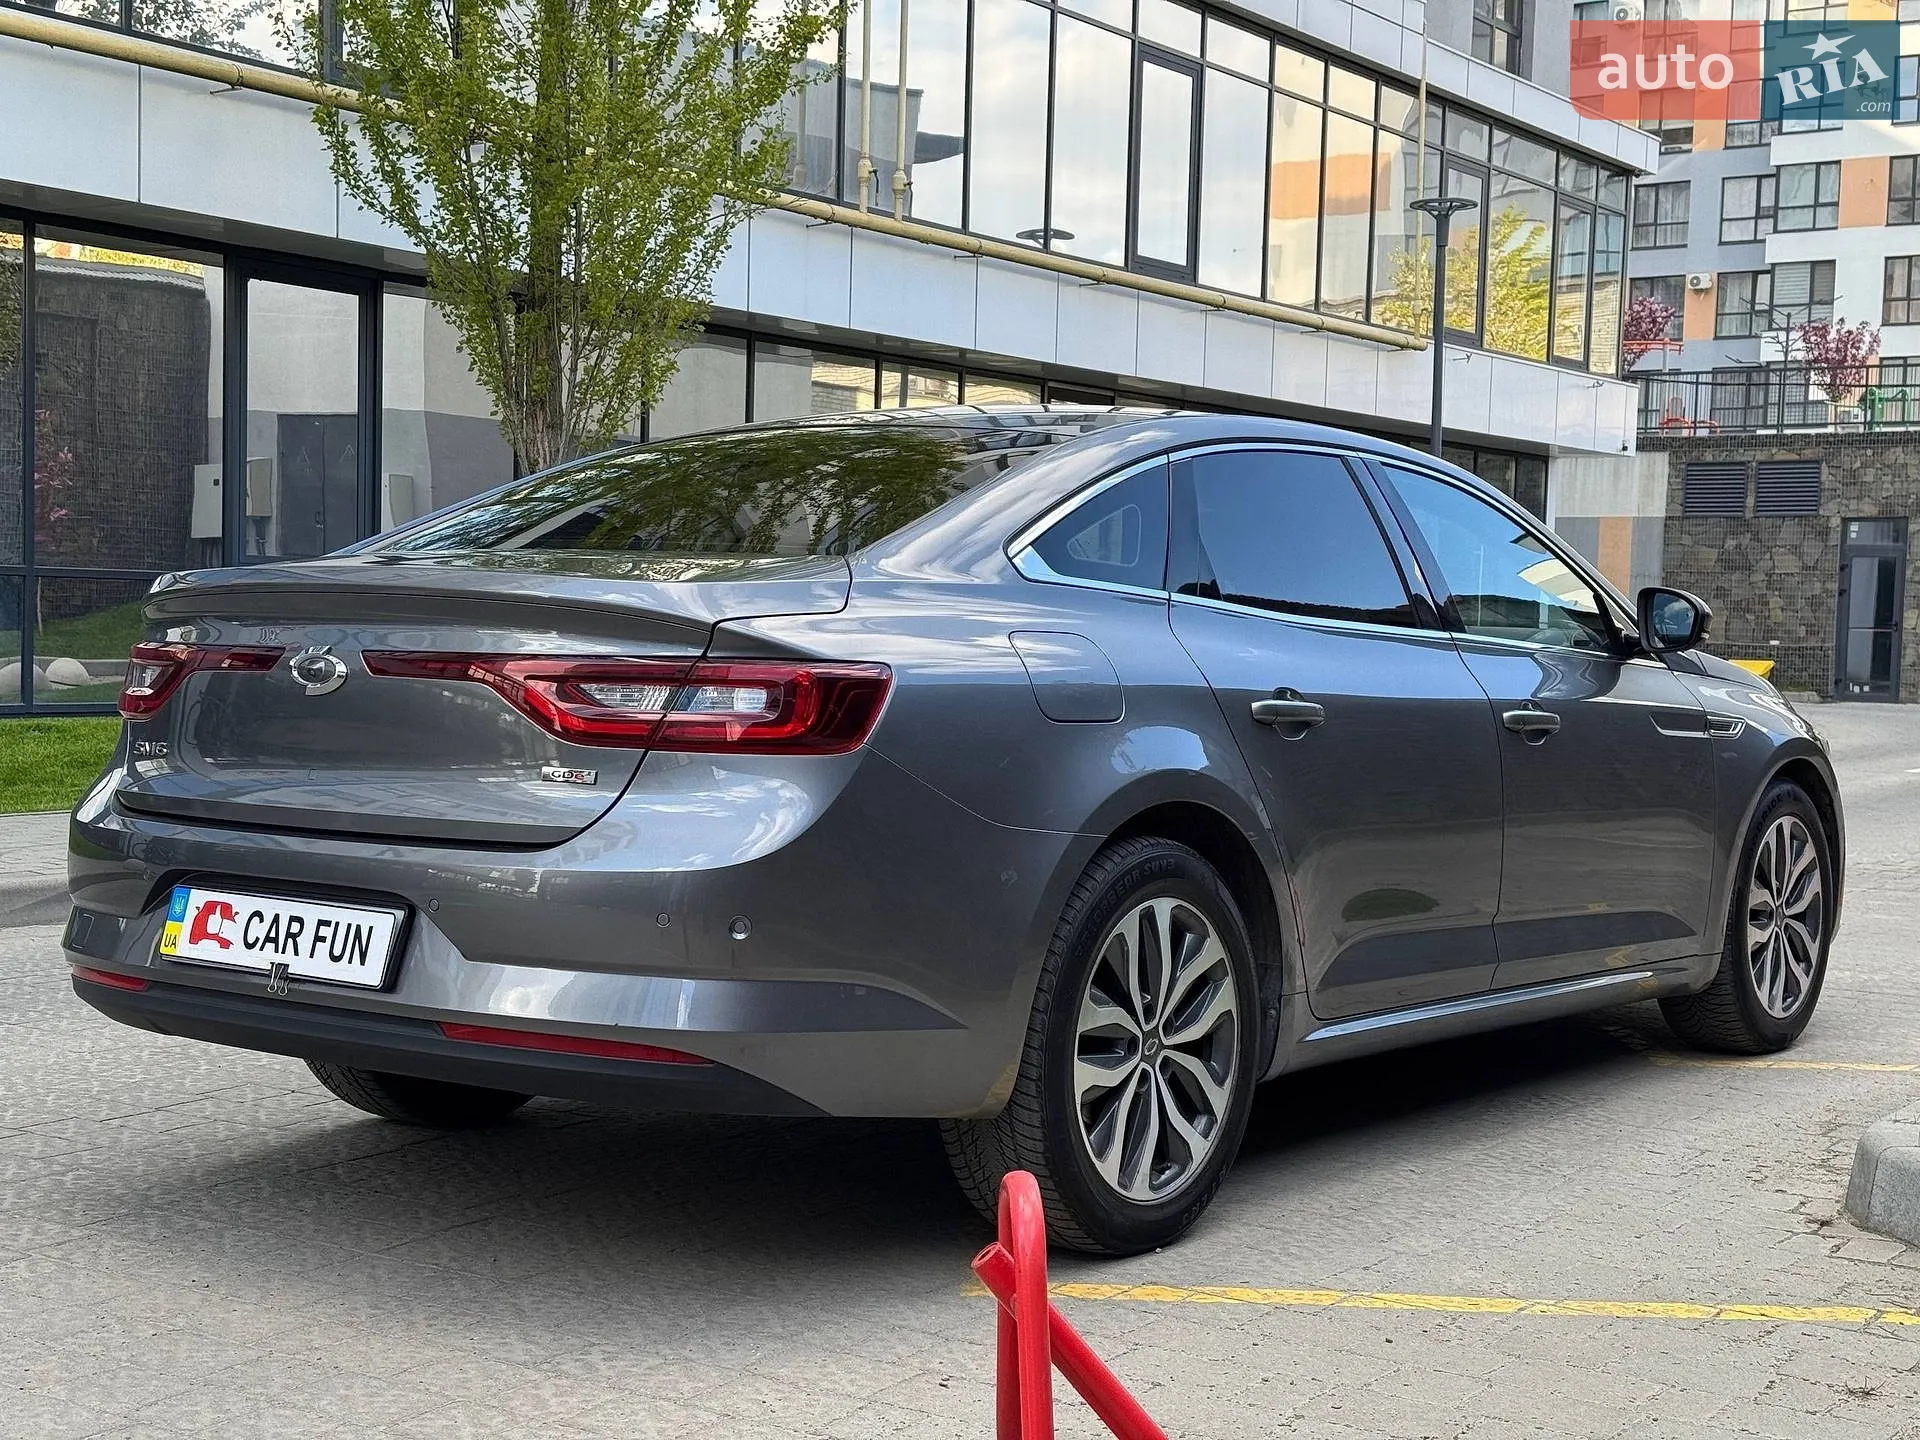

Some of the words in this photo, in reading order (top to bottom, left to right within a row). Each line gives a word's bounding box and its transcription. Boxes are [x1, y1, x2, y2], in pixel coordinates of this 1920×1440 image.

[164, 932, 177, 950] UA
[243, 910, 304, 956] CAR
[309, 919, 373, 966] FUN
